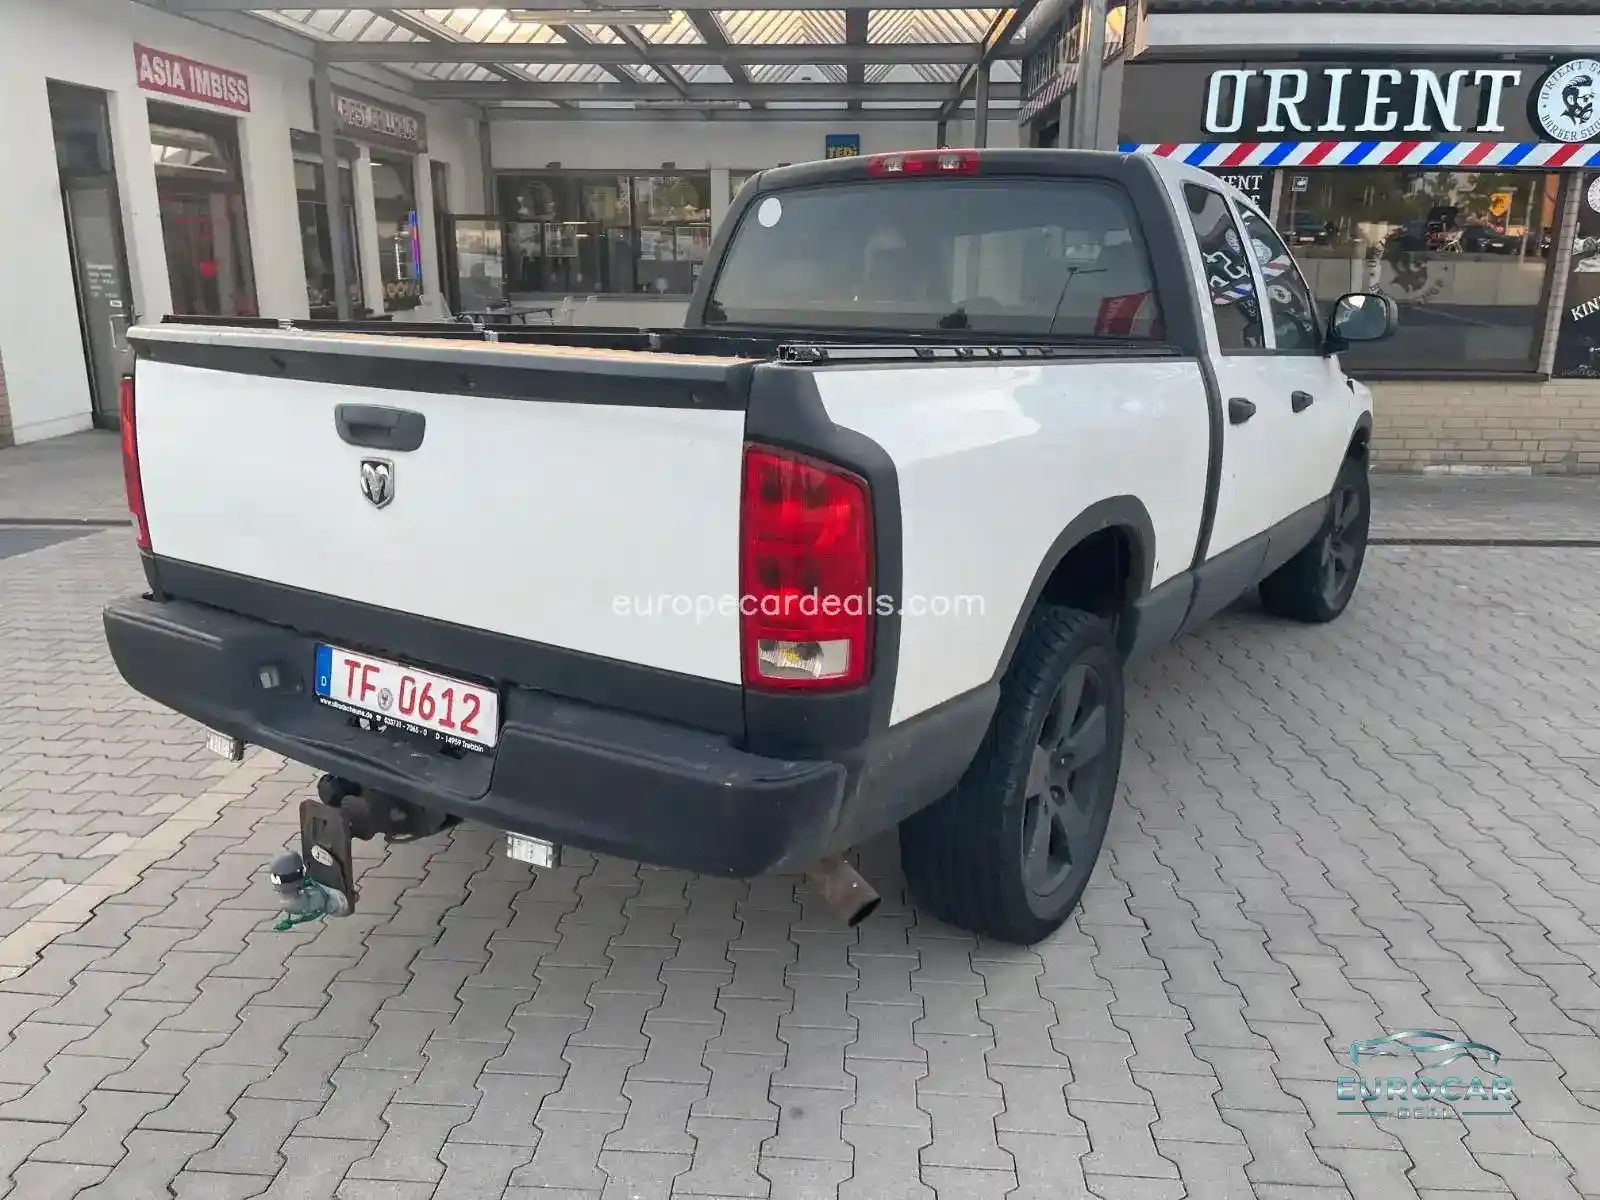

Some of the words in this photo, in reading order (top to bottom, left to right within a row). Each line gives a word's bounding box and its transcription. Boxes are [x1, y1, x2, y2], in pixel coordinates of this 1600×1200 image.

[140, 53, 185, 90] ASIA
[188, 65, 248, 106] IMBISS
[1205, 69, 1522, 133] ORIENT
[1571, 295, 1600, 322] KIN
[321, 676, 327, 687] D
[344, 658, 380, 701] TF
[398, 676, 481, 735] 0612
[462, 740, 484, 753] Trebbin
